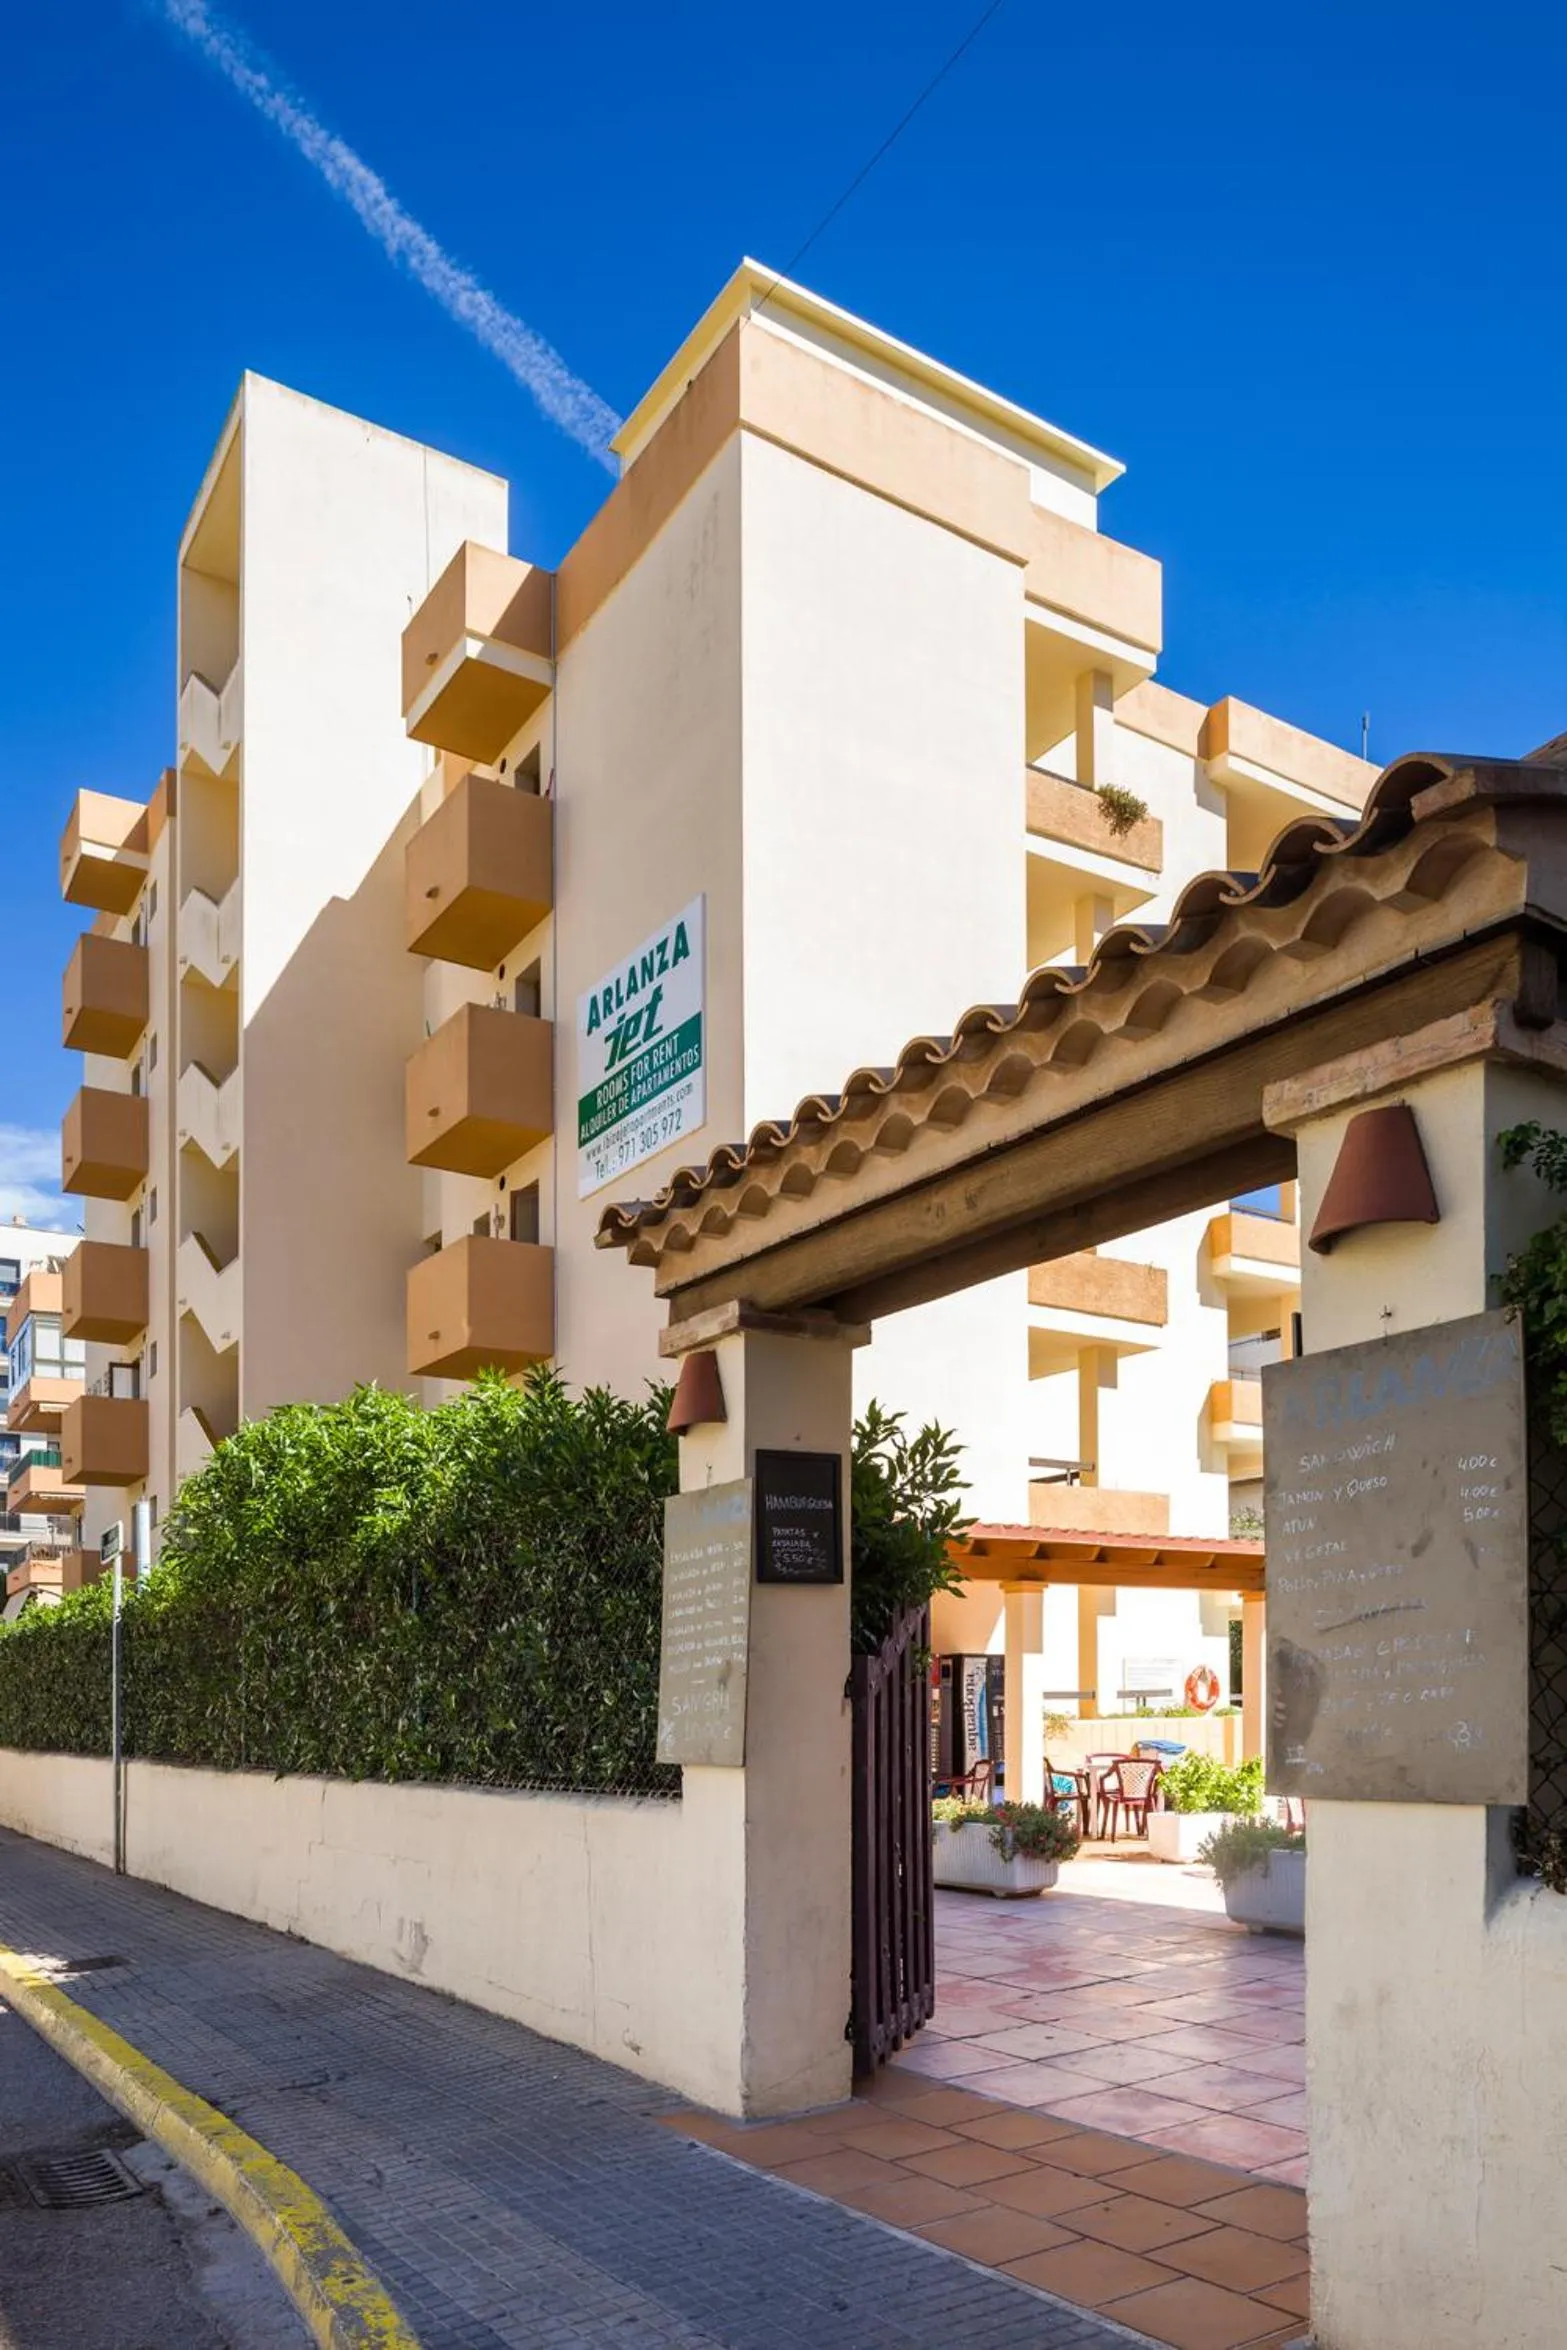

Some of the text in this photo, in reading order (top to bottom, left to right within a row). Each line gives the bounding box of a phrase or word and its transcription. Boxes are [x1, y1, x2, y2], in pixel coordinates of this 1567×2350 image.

[587, 921, 690, 1037] ARLANZA
[580, 1047, 700, 1141] ALQUILER DE APARTAMENTOS
[596, 1033, 680, 1110] ROOMS FOR RENT
[618, 1136, 636, 1167] 971
[639, 1122, 659, 1153] 305
[661, 1107, 683, 1142] 972
